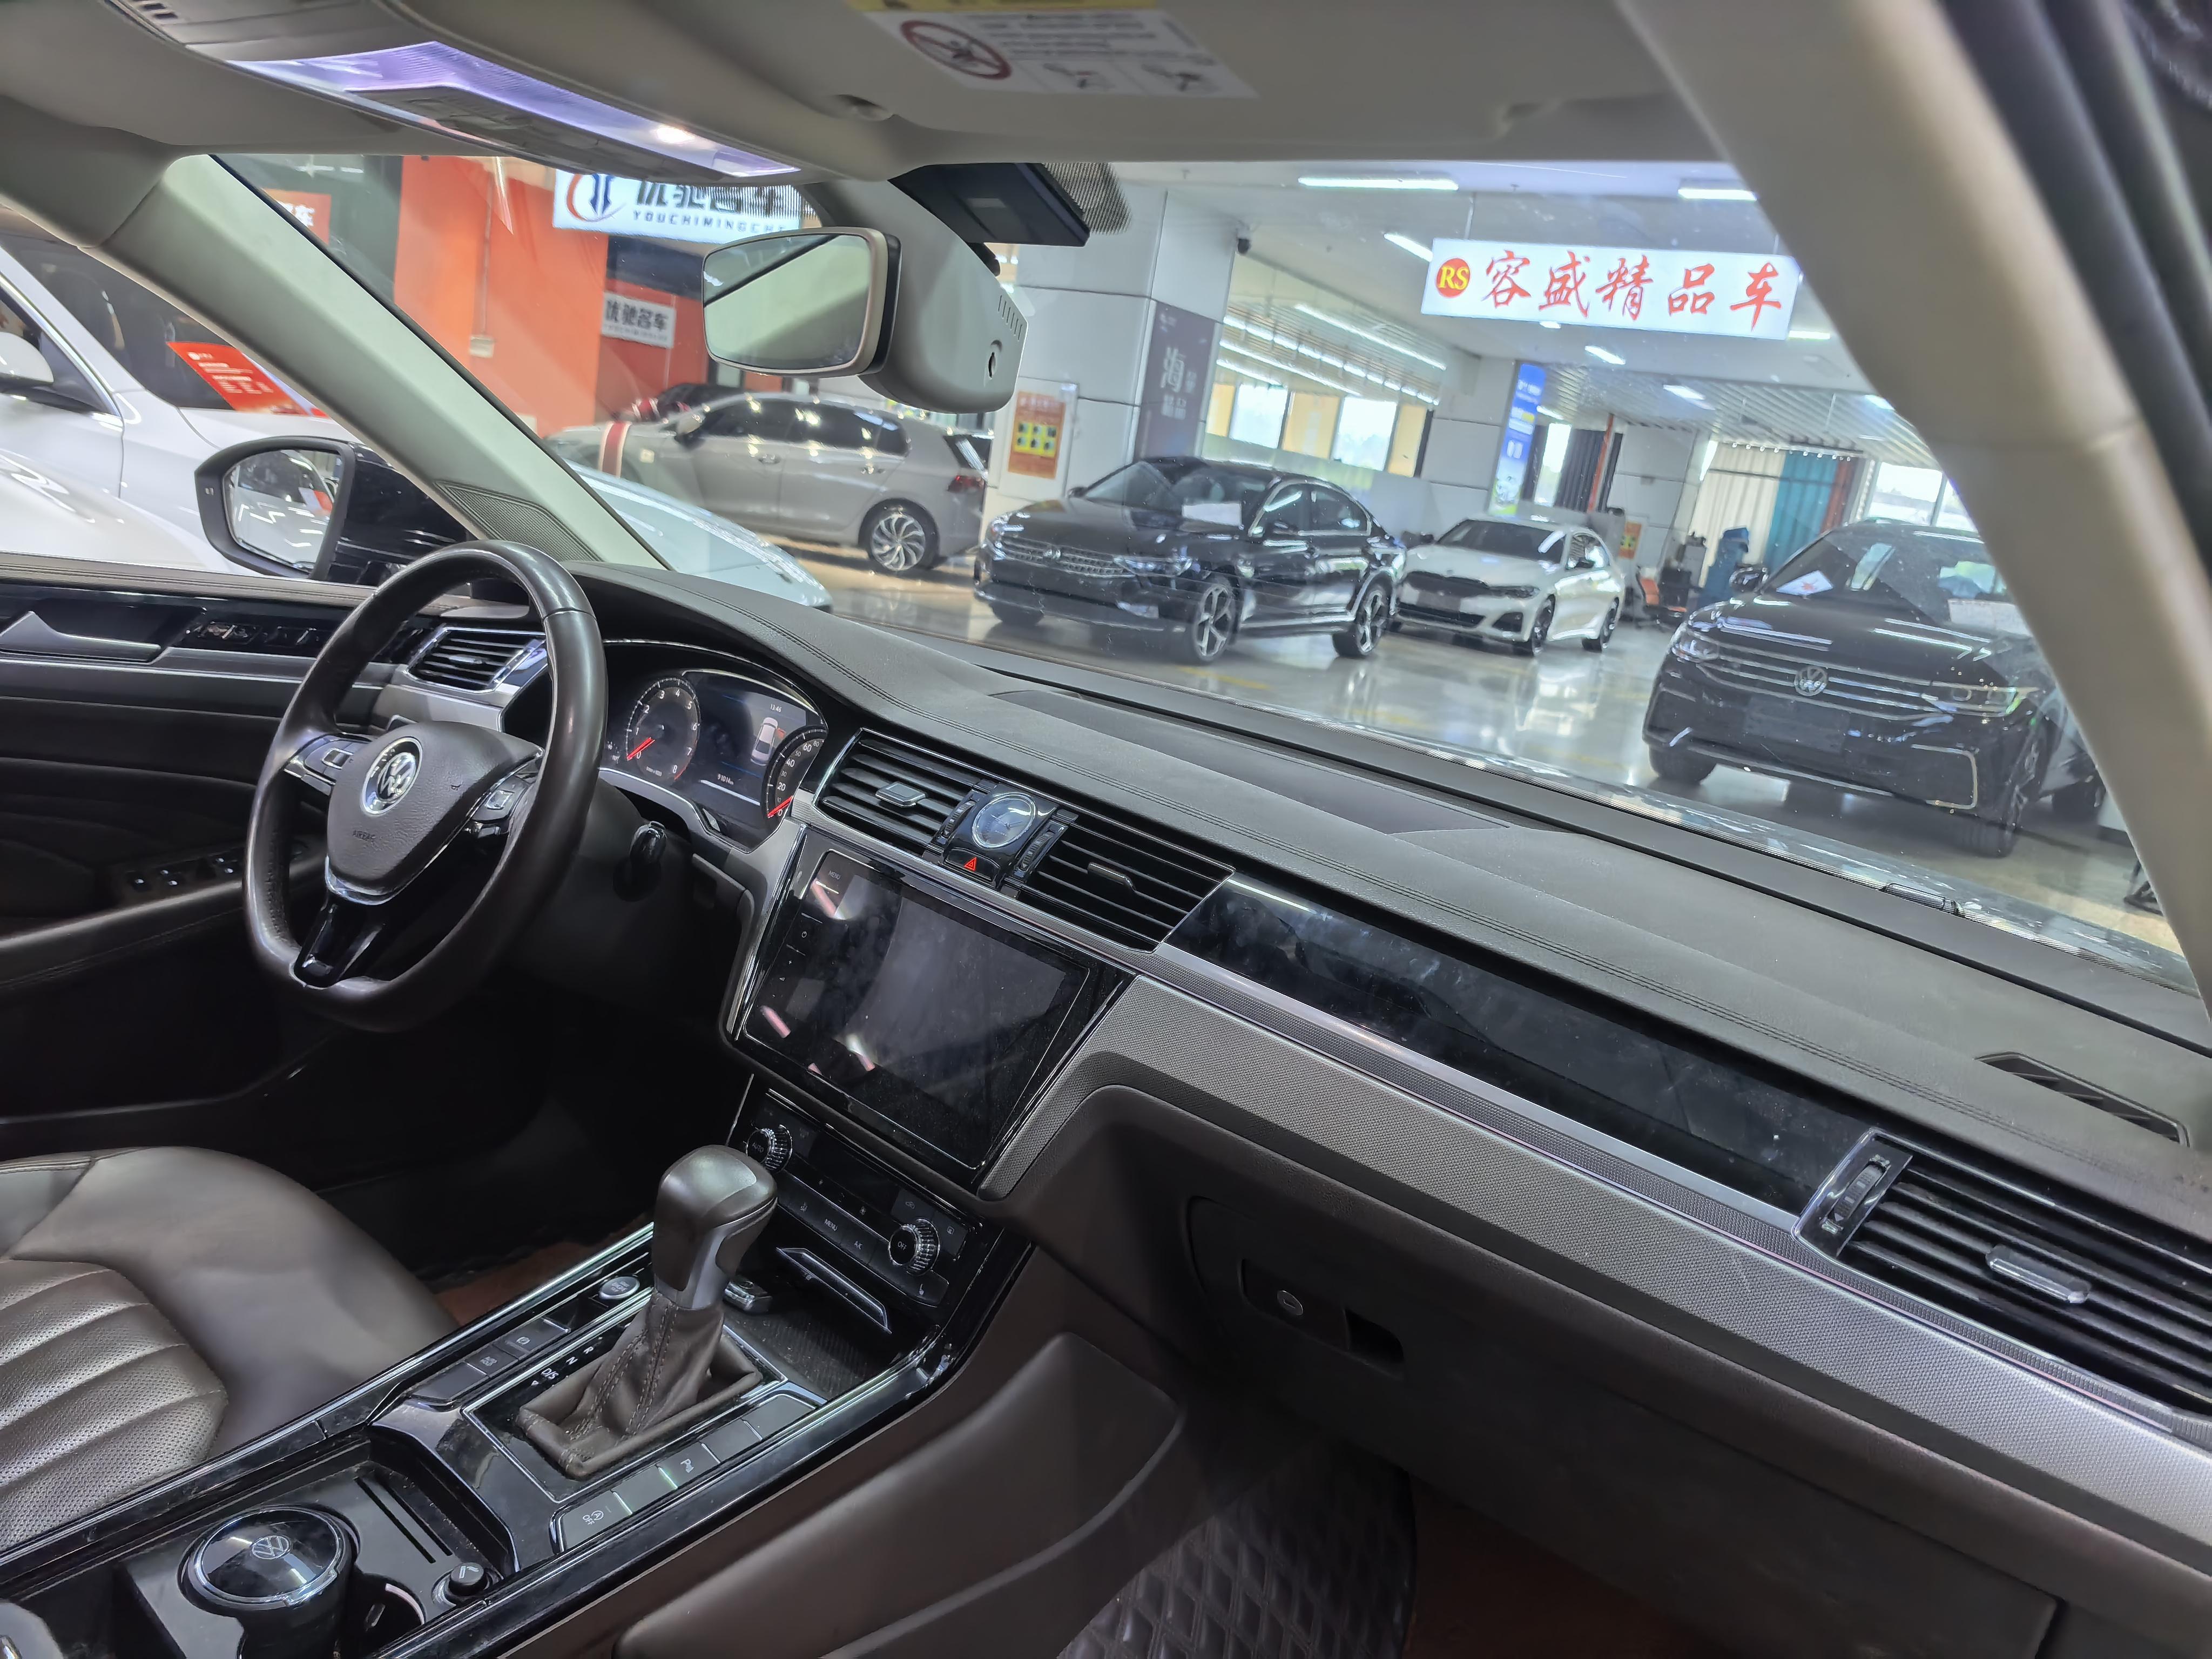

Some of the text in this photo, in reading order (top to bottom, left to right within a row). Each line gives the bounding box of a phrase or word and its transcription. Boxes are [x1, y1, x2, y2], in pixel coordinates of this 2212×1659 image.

[1438, 266, 1469, 290] RS
[1480, 249, 1782, 332] 容盛精品车
[659, 690, 665, 699] 3
[675, 689, 680, 697] 4
[644, 704, 650, 713] 2
[687, 700, 693, 710] 5
[692, 722, 697, 731] 6
[636, 727, 639, 736] 1
[687, 747, 692, 756] 7
[803, 743, 812, 752] 60
[636, 751, 642, 759] 0
[786, 759, 795, 767] 40
[672, 764, 678, 773] 8
[777, 782, 786, 791] 20
[824, 1218, 838, 1231] MENU
[898, 1241, 907, 1251] OFF
[583, 1346, 594, 1354] R
[565, 1356, 578, 1365] N
[541, 1367, 559, 1380] D/S
[582, 1514, 595, 1526] OFF
